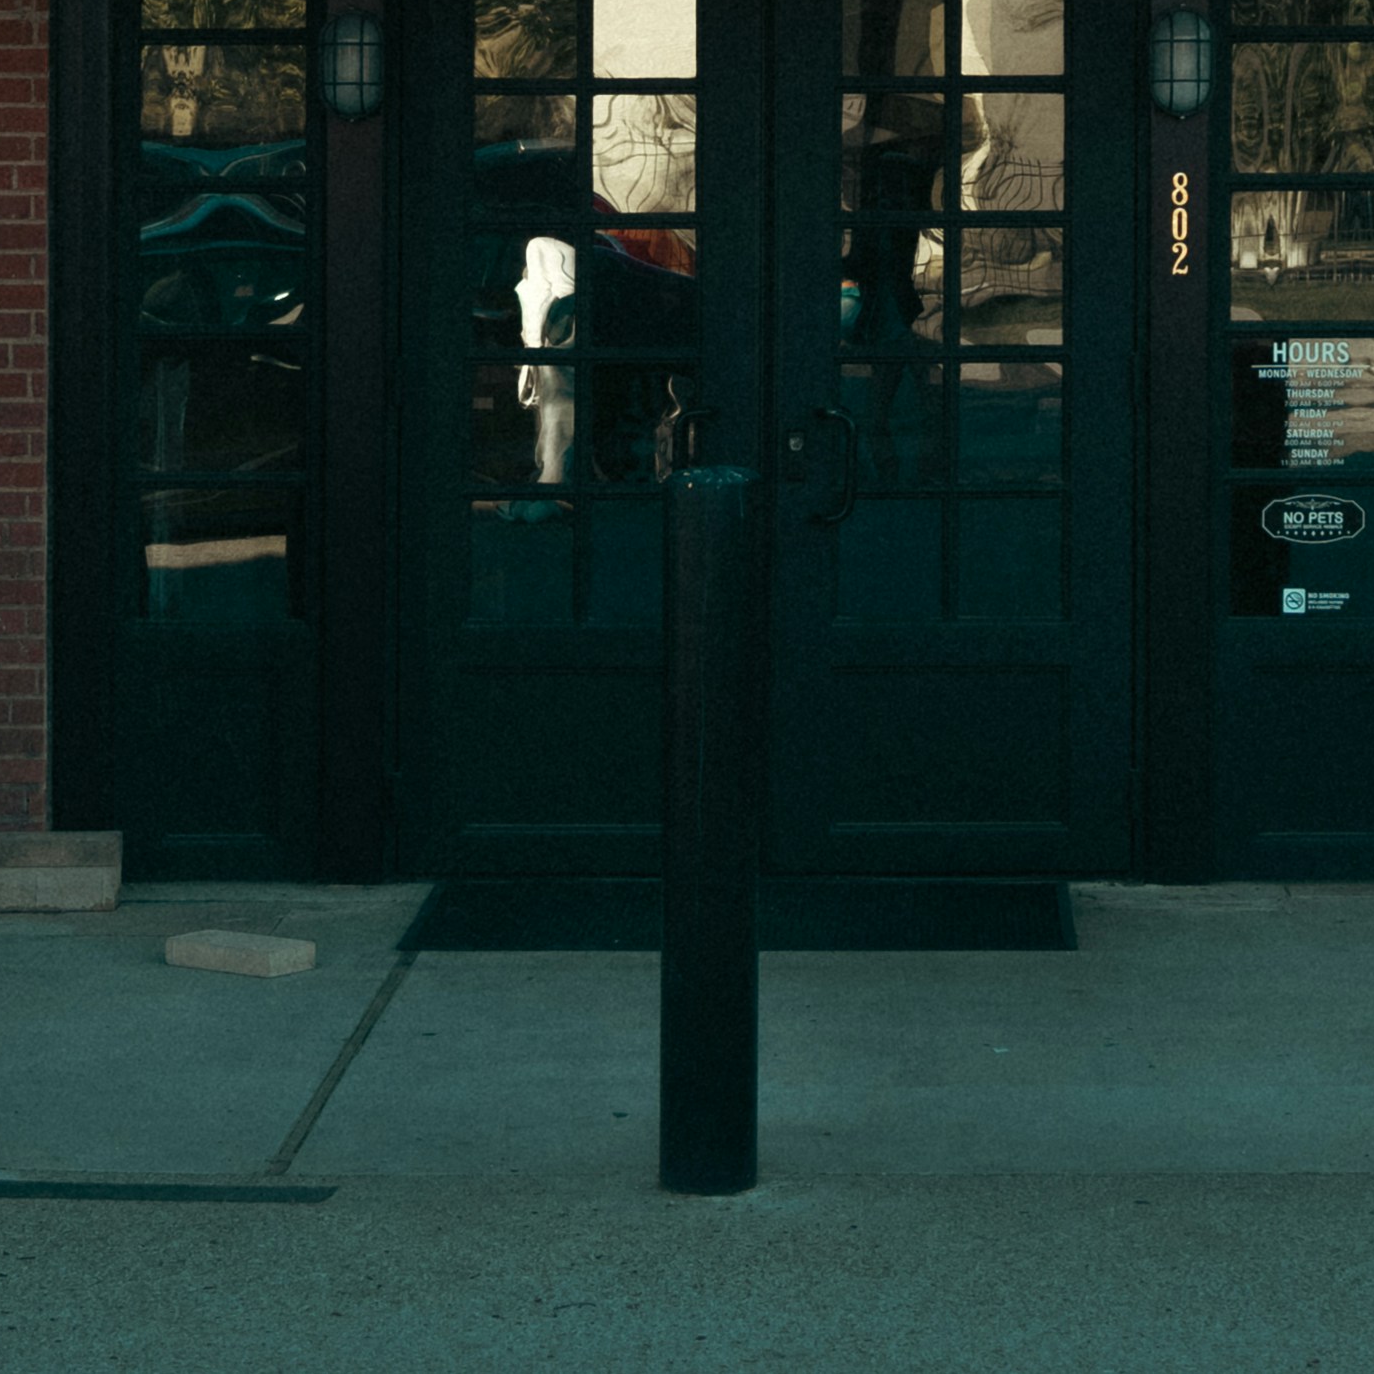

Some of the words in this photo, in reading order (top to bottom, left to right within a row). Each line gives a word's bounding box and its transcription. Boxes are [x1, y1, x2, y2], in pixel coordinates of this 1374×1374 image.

[1171, 171, 1189, 276] 802
[1272, 341, 1350, 363] HOURS
[1258, 369, 1297, 379] MONDAY
[1307, 369, 1364, 379] WEDNESDAY
[1286, 388, 1336, 398] THURSDAY
[1293, 409, 1328, 418] FRIDAY
[1286, 429, 1335, 438] SATURDAY
[1291, 449, 1329, 458] SUNDAY
[1283, 511, 1304, 524] NO
[1308, 511, 1344, 524] PETS
